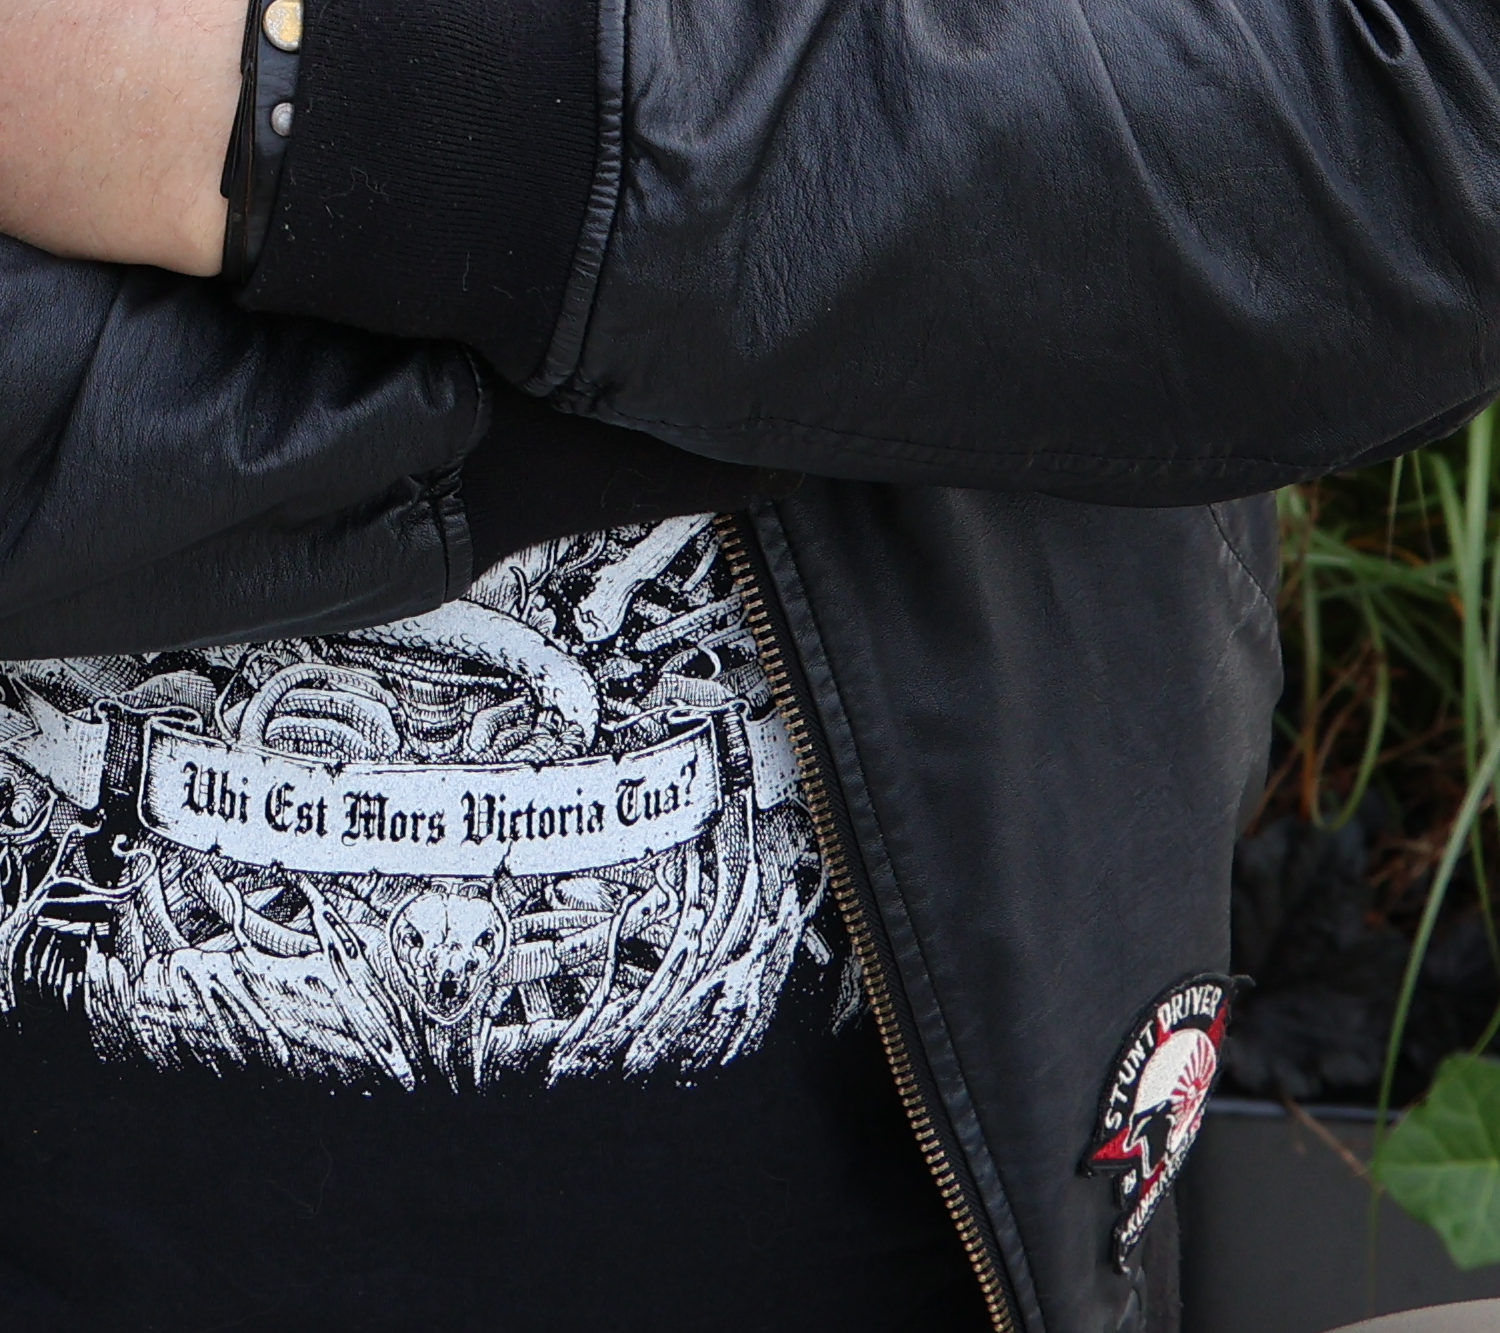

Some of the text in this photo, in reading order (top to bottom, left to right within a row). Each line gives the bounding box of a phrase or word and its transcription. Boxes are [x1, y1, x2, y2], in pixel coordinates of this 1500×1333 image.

[181, 757, 699, 845] Ubi Est Mors Victoria Tua?
[1104, 984, 1222, 1130] STUNT DRIVER
